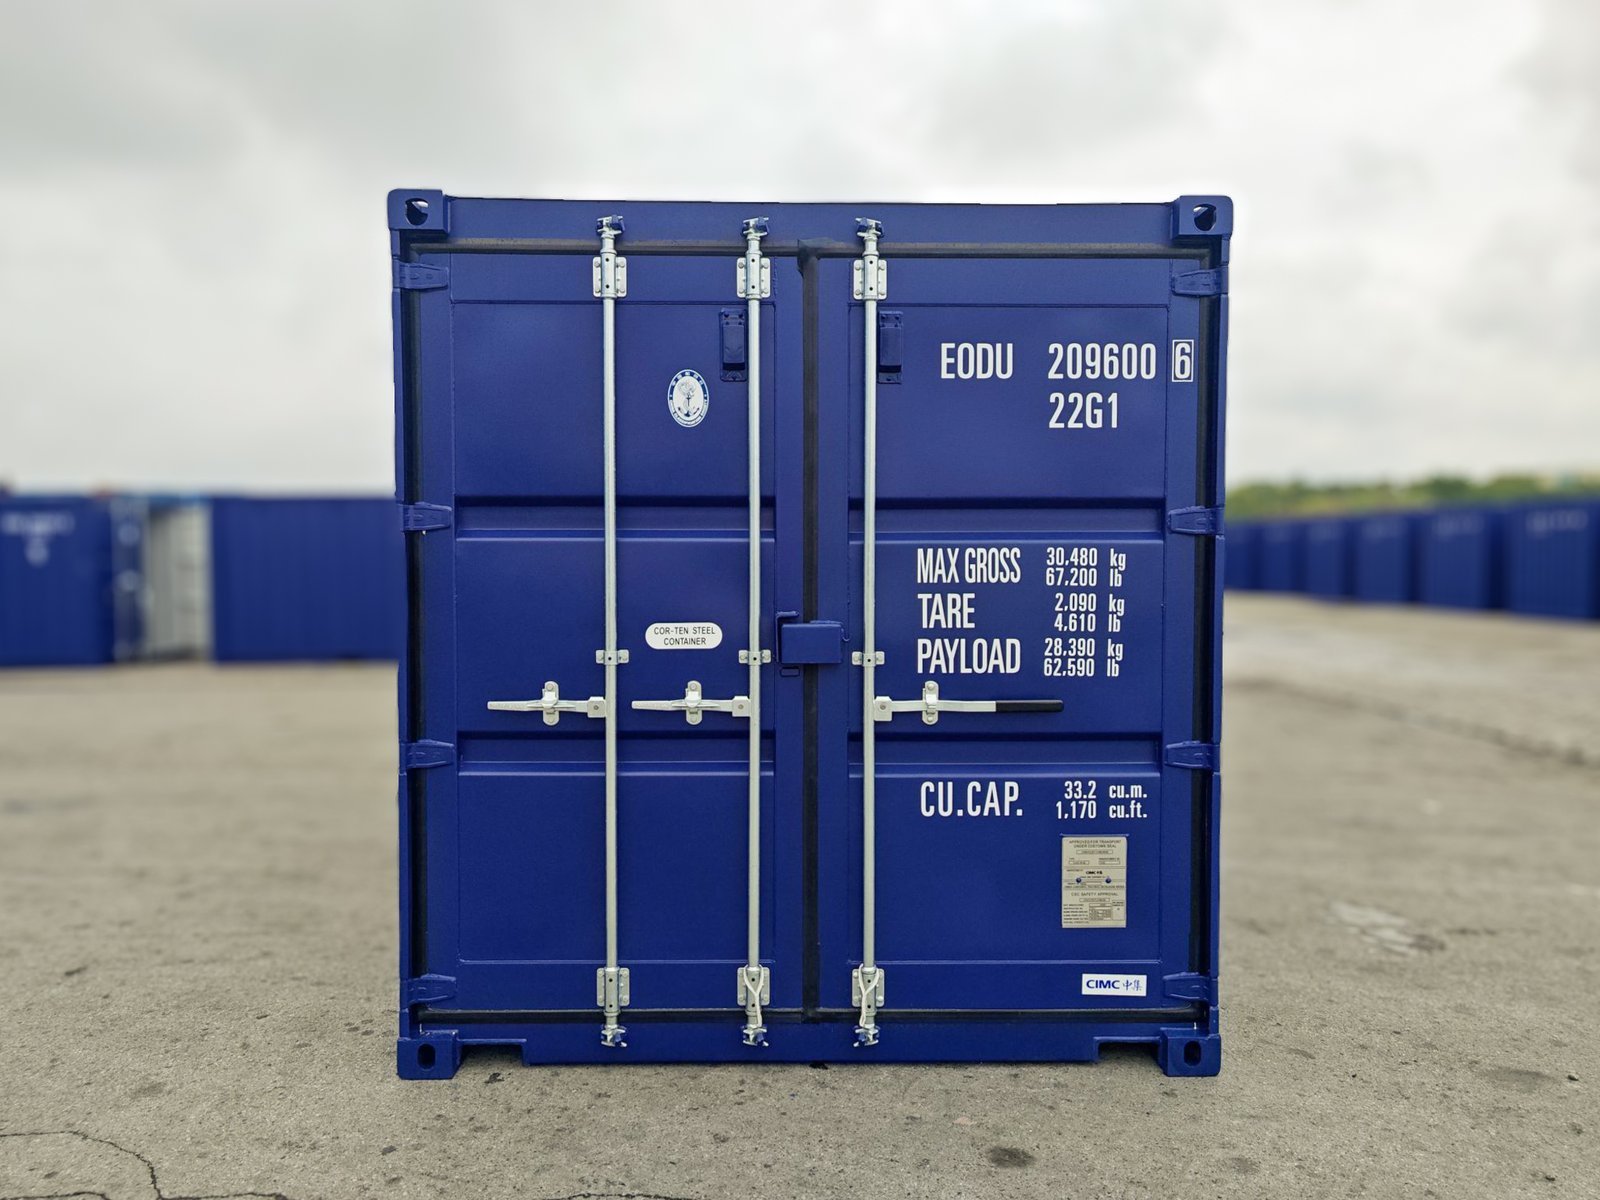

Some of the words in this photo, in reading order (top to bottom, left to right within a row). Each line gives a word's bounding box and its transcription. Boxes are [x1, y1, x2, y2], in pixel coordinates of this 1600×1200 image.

[940, 342, 1014, 380] EODU
[1047, 342, 1157, 380] 209600
[1174, 342, 1191, 380] 6
[1048, 392, 1118, 429] 22G1
[917, 547, 960, 584] MAX
[964, 547, 1021, 584] GROSS
[1109, 548, 1127, 572] kg
[1109, 568, 1125, 587] lb
[917, 592, 976, 629] TARE
[1108, 593, 1125, 617] kg
[653, 626, 689, 635] COR-TEN
[692, 626, 716, 635] STEEL
[1108, 614, 1123, 633] lb
[663, 637, 707, 646] CONTAINER
[917, 638, 1021, 674] PAYLOAD
[1107, 638, 1124, 662] kg
[1106, 659, 1121, 677] lb
[920, 781, 1023, 817] CU.CAP.
[1064, 780, 1097, 800] 33.2
[1108, 784, 1148, 799] cu.m.
[1109, 799, 1148, 819] cu.ft.
[1086, 979, 1120, 990] CIMC
